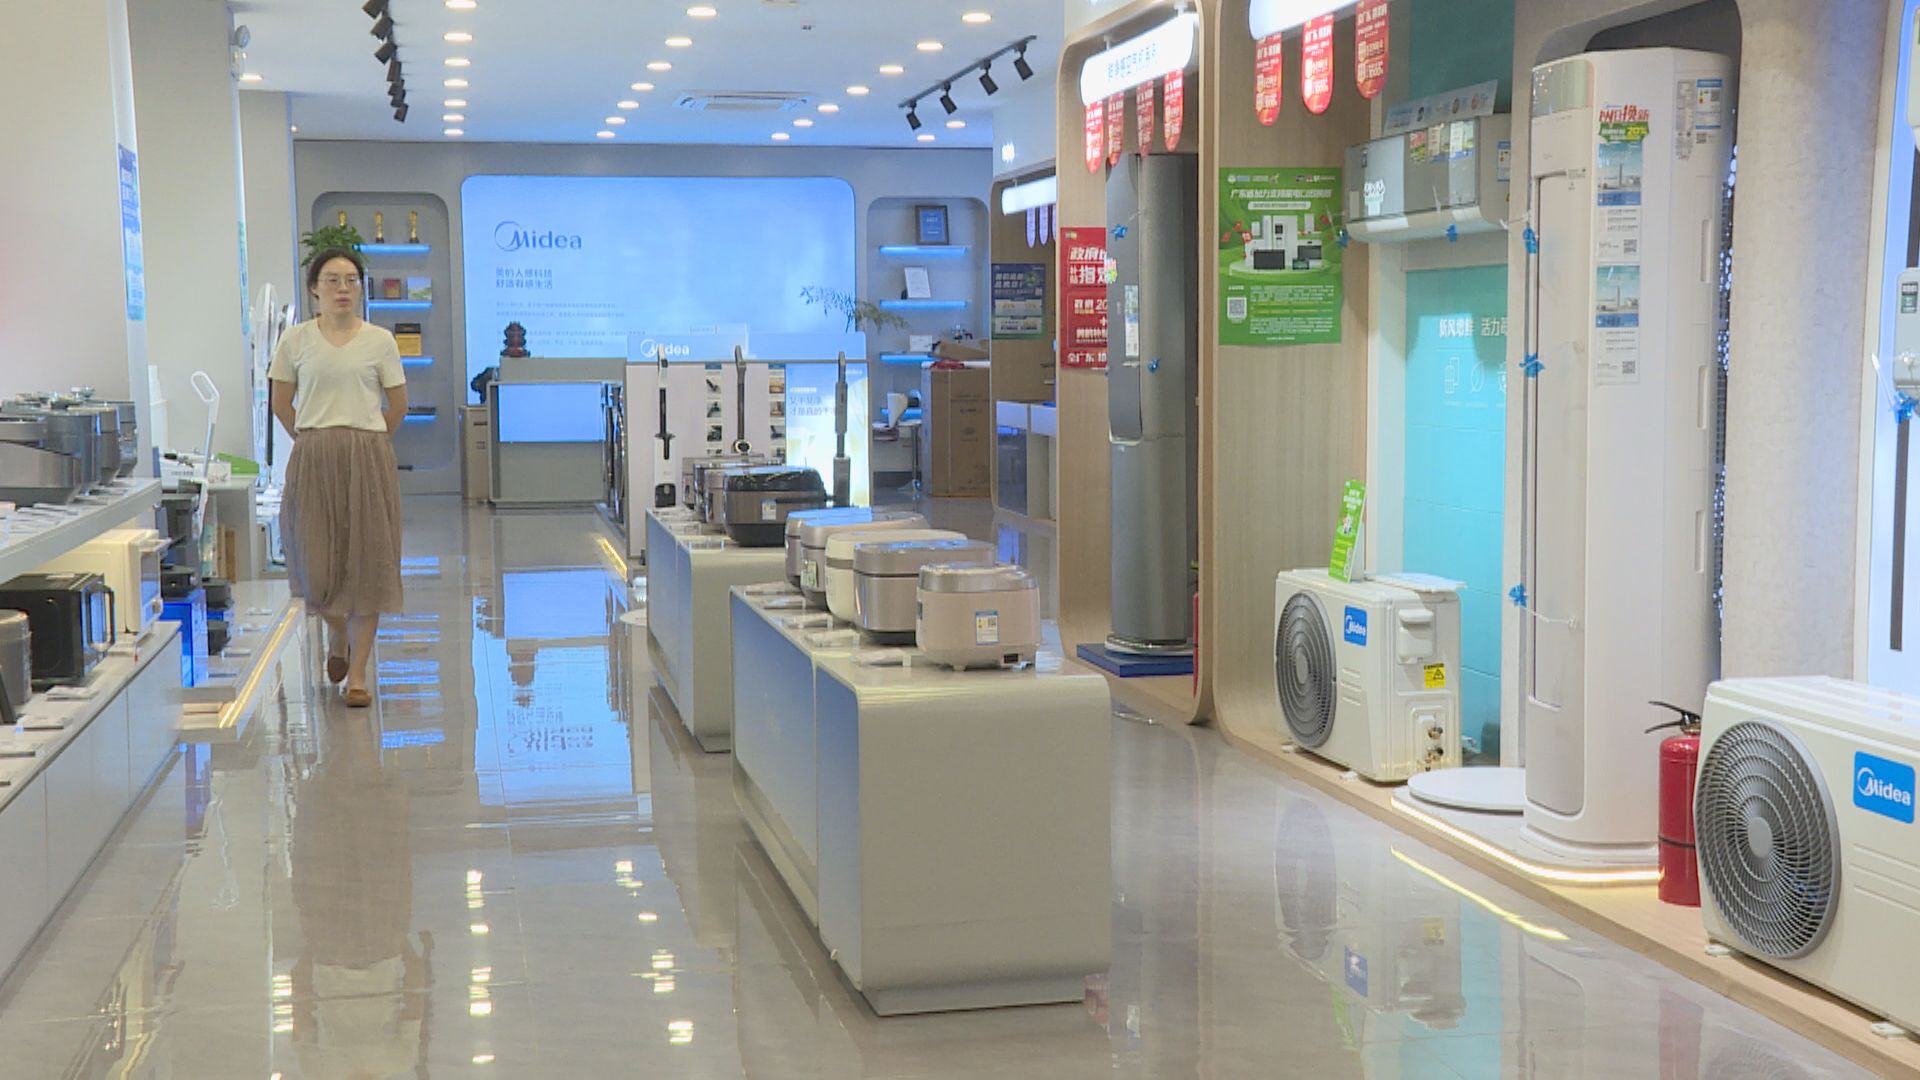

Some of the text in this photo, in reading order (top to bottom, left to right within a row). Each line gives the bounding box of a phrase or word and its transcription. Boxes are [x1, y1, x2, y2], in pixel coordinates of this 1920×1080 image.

[494, 220, 582, 252] Midea
[495, 267, 553, 278] 美的人感科技
[1345, 614, 1367, 637] Midea
[1856, 766, 1911, 807] Midea
